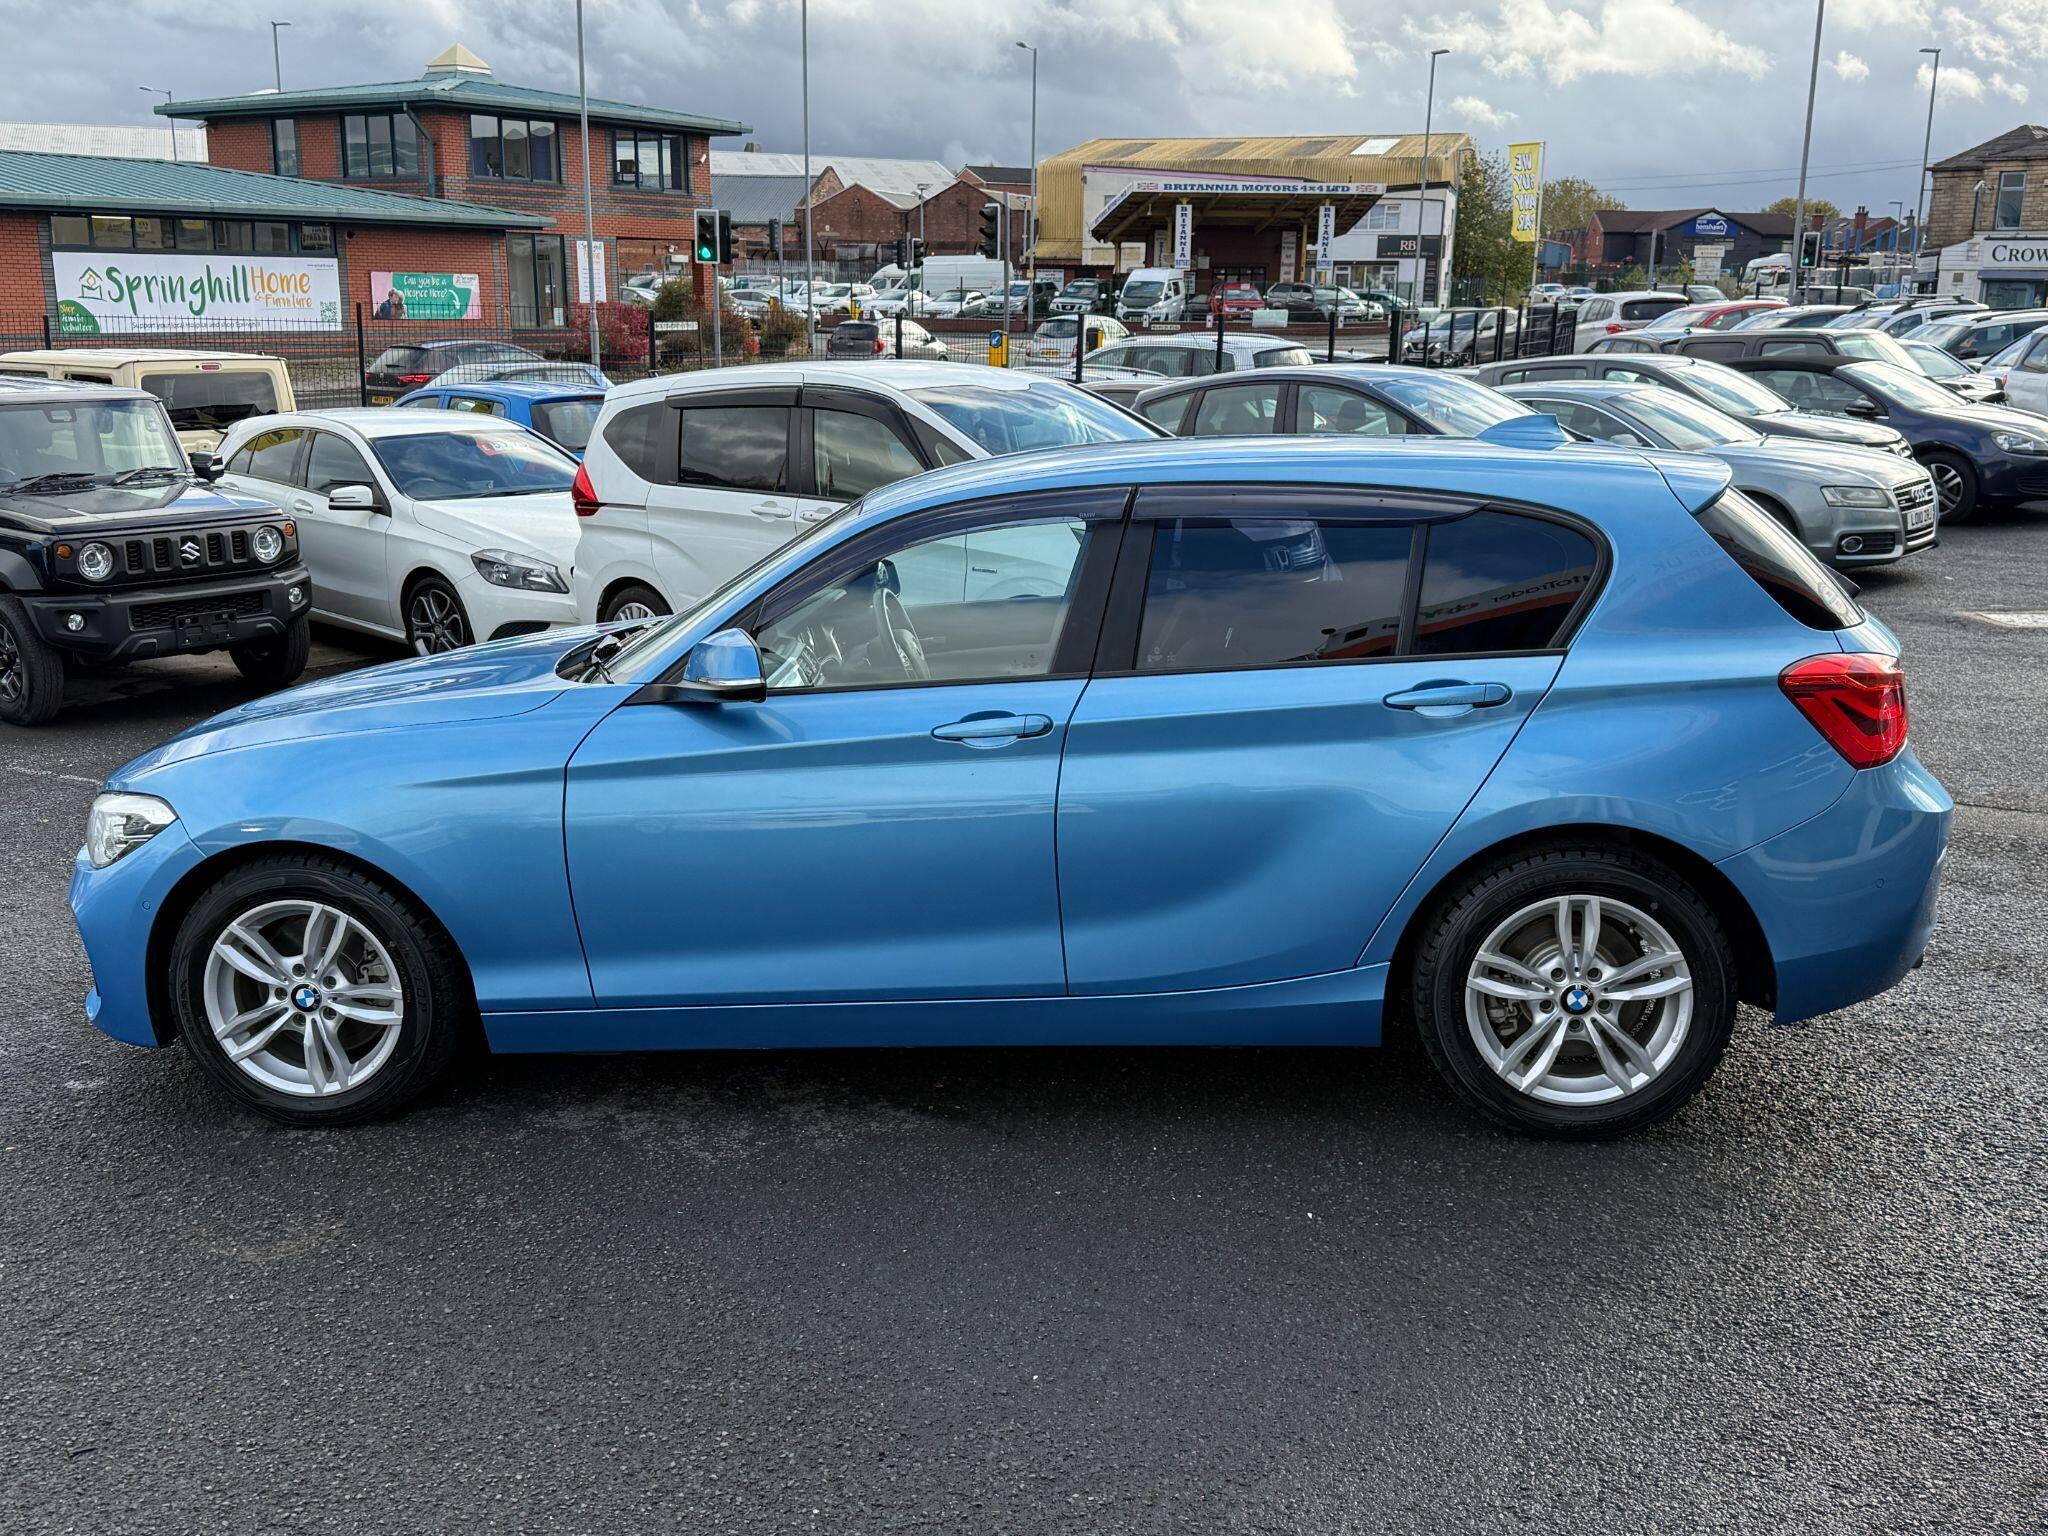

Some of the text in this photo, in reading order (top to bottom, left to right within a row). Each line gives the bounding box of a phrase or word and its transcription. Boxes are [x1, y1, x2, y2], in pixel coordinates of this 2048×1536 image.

[1163, 183, 1350, 193] BRITANNIA MOTORS 4x4 LTD
[1179, 206, 1188, 259] BRITANNIA
[1321, 207, 1331, 259] BRITANNIA
[1399, 240, 1418, 251] RB
[403, 275, 417, 286] Can
[418, 276, 431, 289] you
[431, 275, 440, 286] be
[105, 264, 312, 316] Springhill Home
[1079, 511, 1096, 519] BMW
